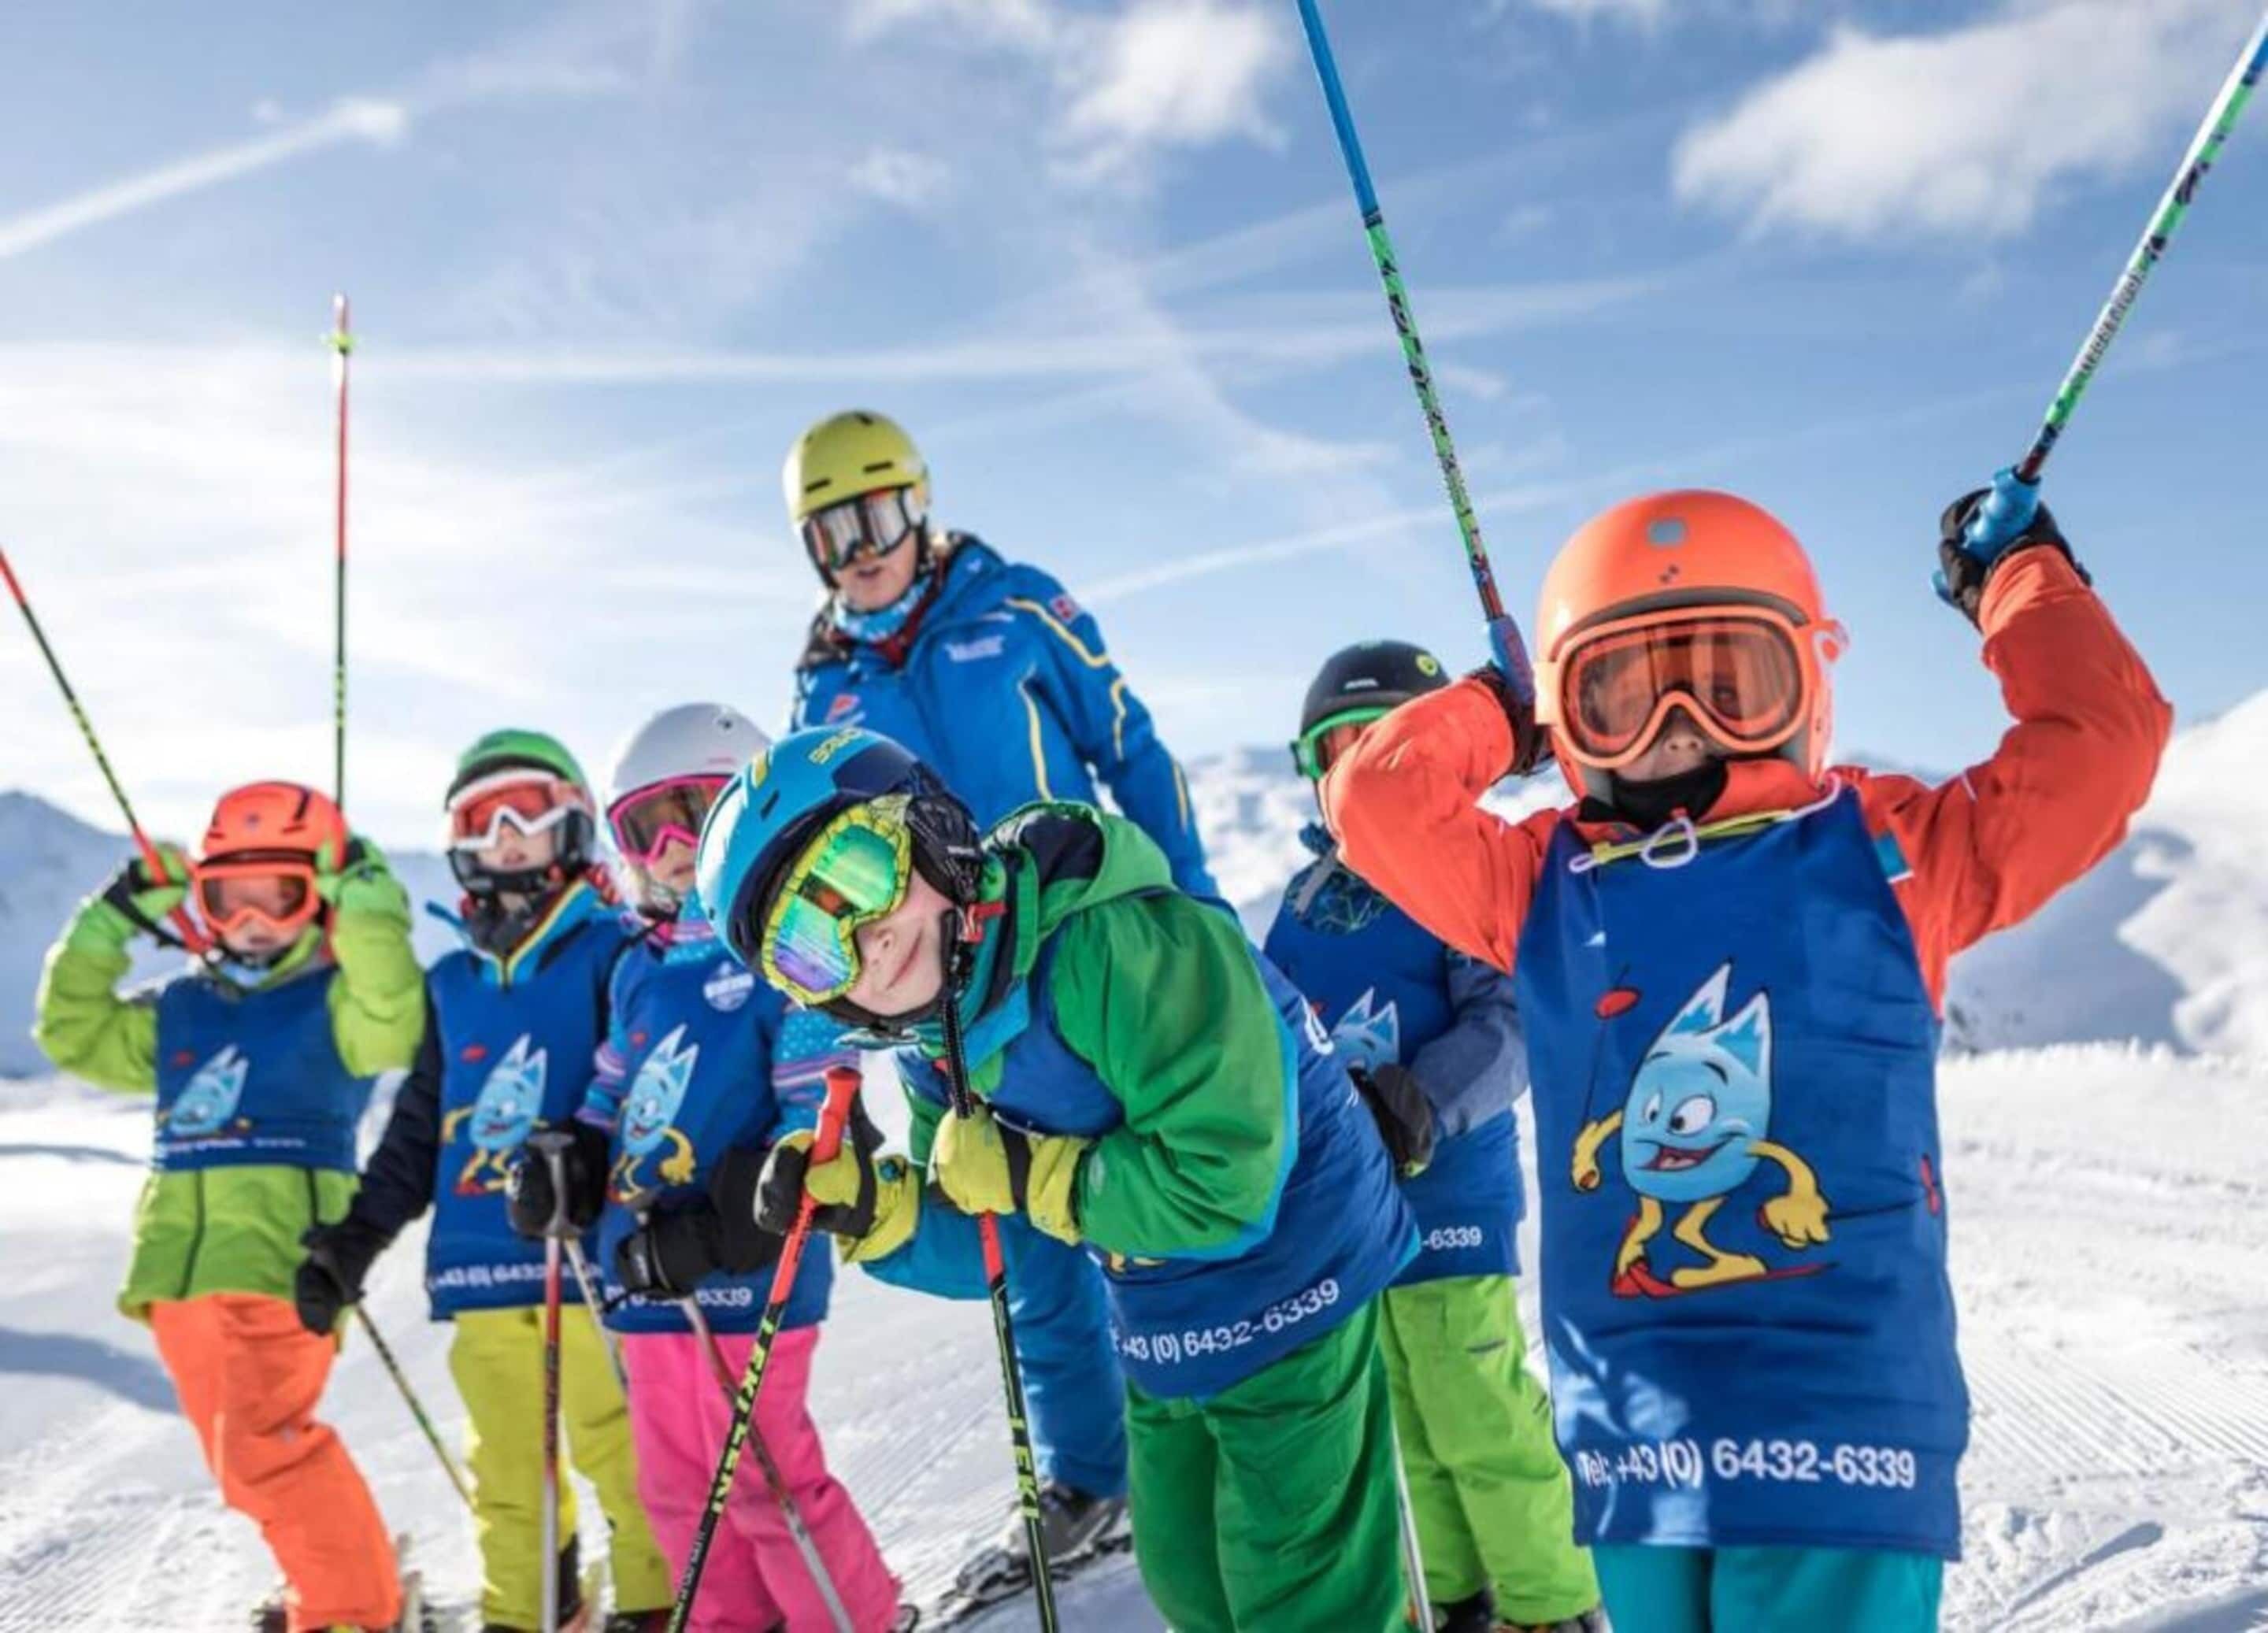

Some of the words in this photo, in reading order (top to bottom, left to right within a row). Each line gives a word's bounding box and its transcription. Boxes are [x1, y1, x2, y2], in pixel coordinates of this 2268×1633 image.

[1151, 1332, 1181, 1364] (0)
[1184, 1278, 1340, 1357] 6432-6339
[1007, 1417, 1040, 1519] LEKI
[1711, 1438, 1916, 1490] 6432-6339
